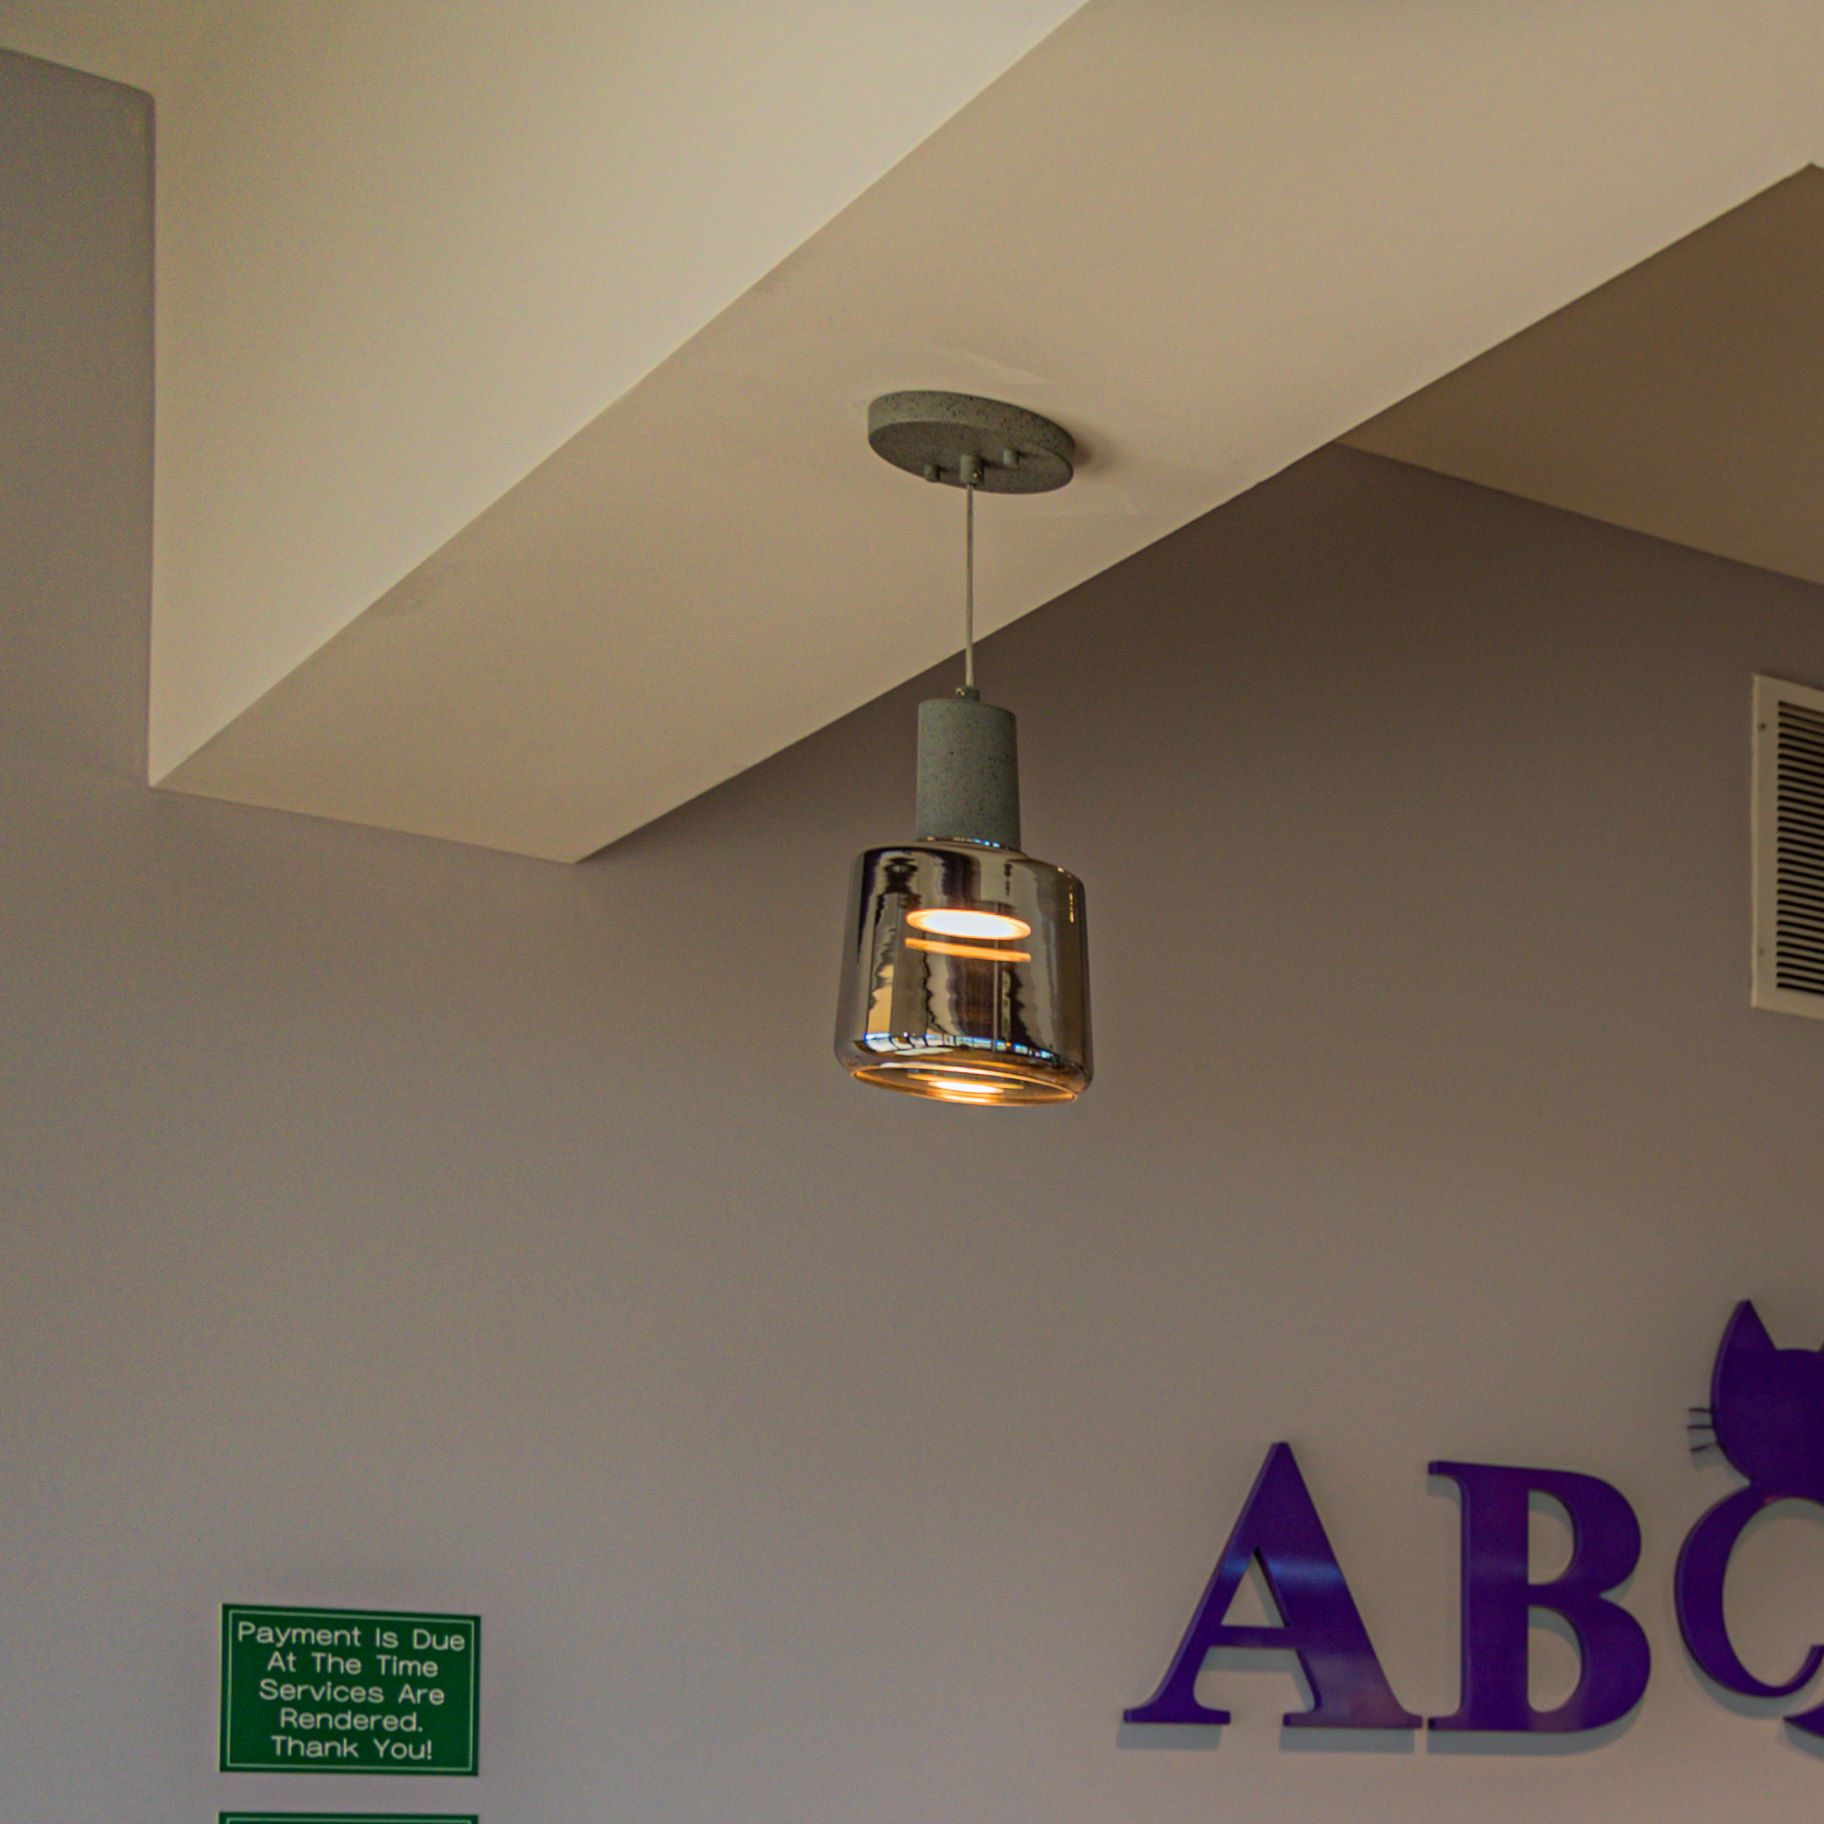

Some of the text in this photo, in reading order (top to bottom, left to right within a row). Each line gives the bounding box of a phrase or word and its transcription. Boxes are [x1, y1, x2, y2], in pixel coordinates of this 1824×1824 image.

[237, 1620, 465, 1651] Payment Is Due
[267, 1650, 439, 1678] At The Time
[259, 1678, 445, 1705] Services Are
[279, 1707, 424, 1733] Rendered.
[271, 1735, 433, 1760] Thank You!
